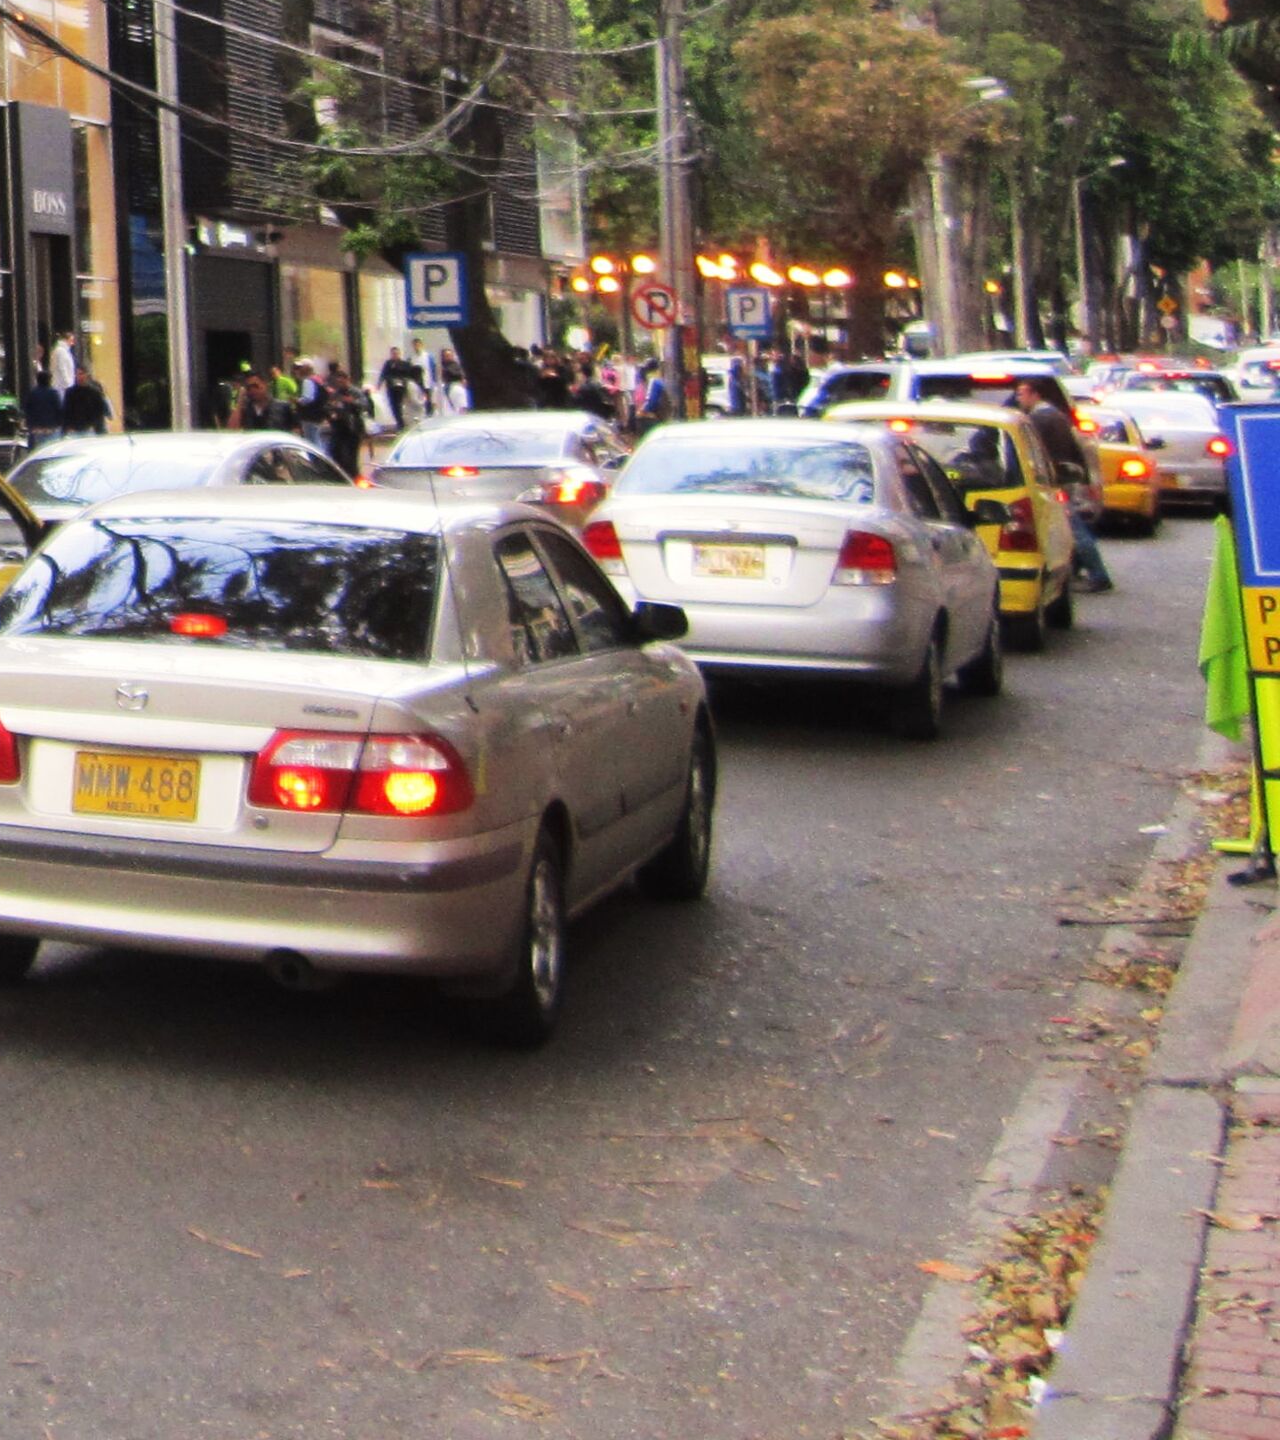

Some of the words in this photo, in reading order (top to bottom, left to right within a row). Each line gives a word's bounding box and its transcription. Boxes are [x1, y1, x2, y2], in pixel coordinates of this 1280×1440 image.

[33, 190, 66, 216] BOSS
[424, 264, 448, 301] P
[740, 297, 755, 321] P
[79, 762, 131, 798] MMW
[141, 766, 192, 802] 488
